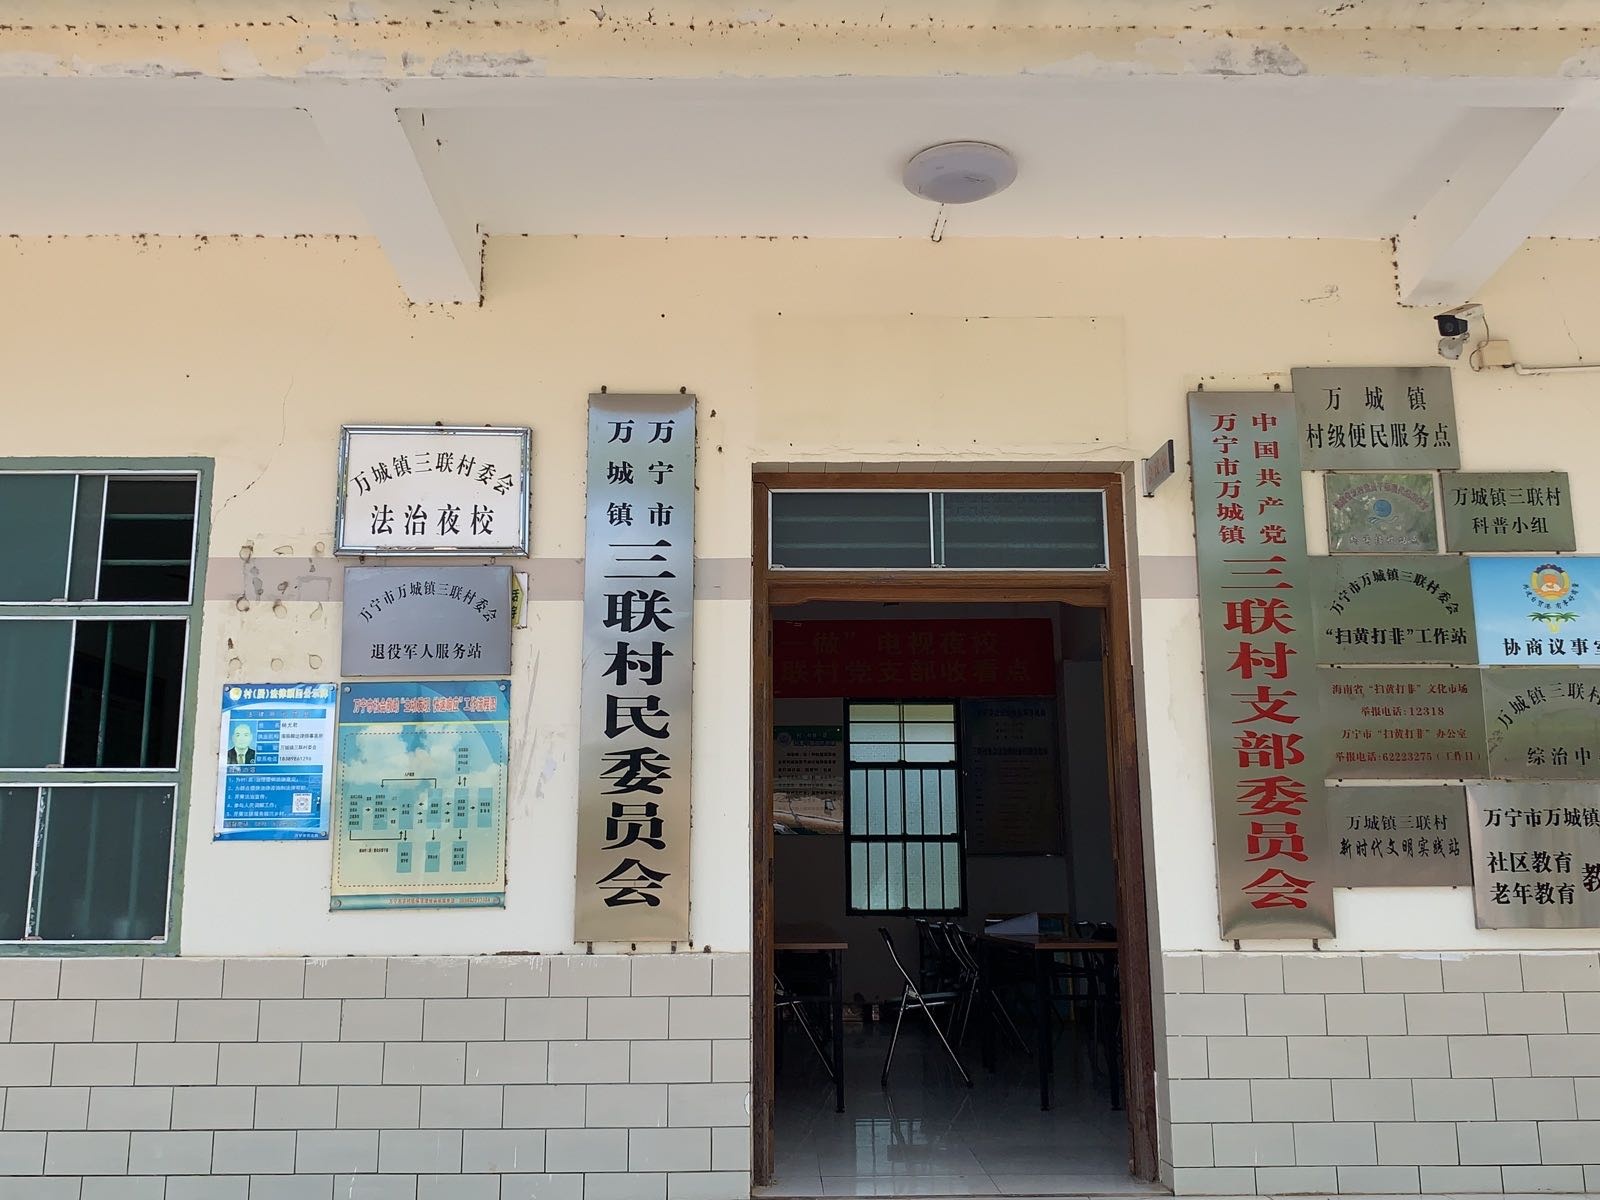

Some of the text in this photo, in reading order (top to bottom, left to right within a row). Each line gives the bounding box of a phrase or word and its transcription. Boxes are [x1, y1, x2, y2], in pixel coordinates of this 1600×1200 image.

[1322, 386, 1427, 411] 万城镇
[1306, 422, 1451, 449] 村级便民服务点
[349, 451, 515, 498] 万城镇三联村委会
[606, 419, 635, 529] 万城镇
[647, 418, 676, 528] 万宁市
[1210, 413, 1246, 544] 万宁市万城镇
[1252, 412, 1287, 544] 中国共产党
[1452, 487, 1561, 507] 万城镇三联村
[370, 503, 495, 537] 法治夜校
[1472, 516, 1549, 534] 科普小组
[357, 579, 499, 623] 万宁市万城镇三联村委会
[1329, 568, 1460, 616] 万宁市万城镇三联村委会
[1326, 627, 1467, 645] “扫黄打非”工作站
[371, 642, 483, 662] 退役军人服务站
[1497, 682, 1600, 731] 万城镇三联村
[595, 539, 678, 908] 三联村民委员会
[1220, 555, 1317, 910] 三联村支部委员会
[1527, 746, 1600, 766] 综治中
[1346, 814, 1447, 830] 万城镇三联村
[1483, 808, 1600, 828] 万宁市万城镇
[1339, 837, 1460, 858] 新时代文明实践站
[1486, 851, 1573, 873] 社区教育
[1490, 882, 1576, 905] 老年教育
